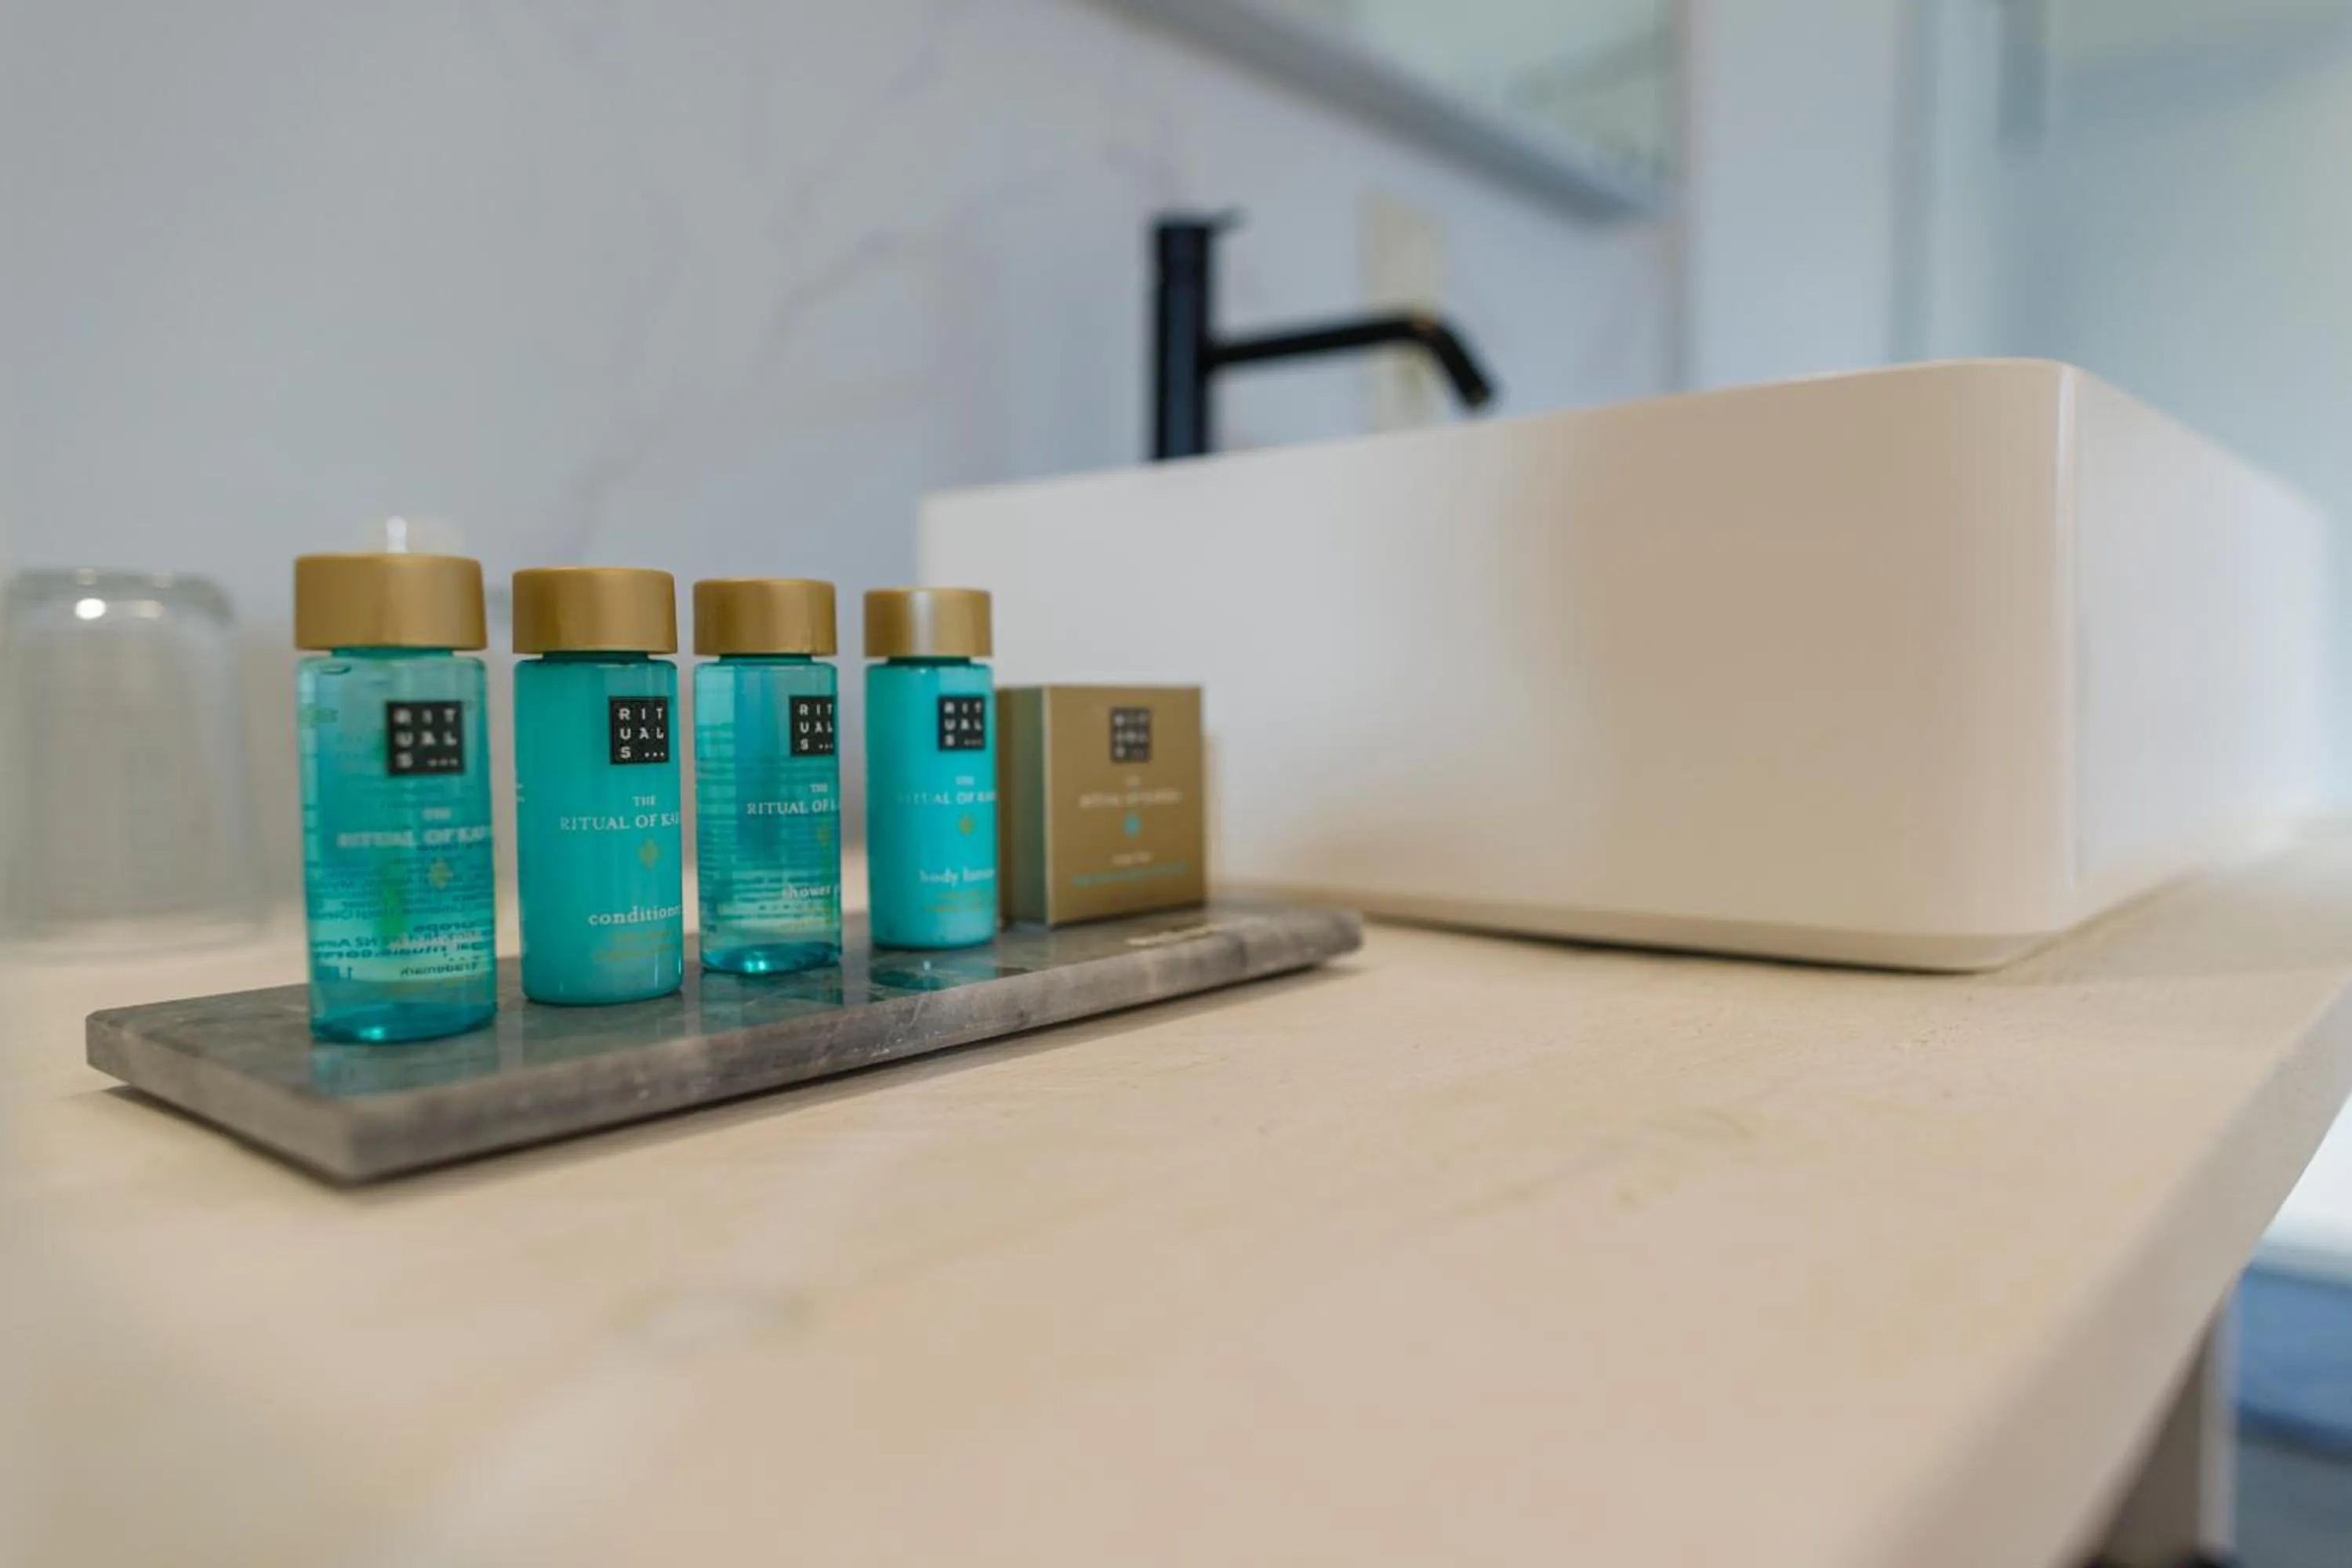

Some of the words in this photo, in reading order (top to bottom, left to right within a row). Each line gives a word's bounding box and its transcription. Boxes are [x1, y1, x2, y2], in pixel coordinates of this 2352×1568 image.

[632, 794, 656, 807] THE
[747, 801, 808, 815] RITUAL
[560, 815, 630, 830] RITUAL
[635, 813, 657, 829] OF
